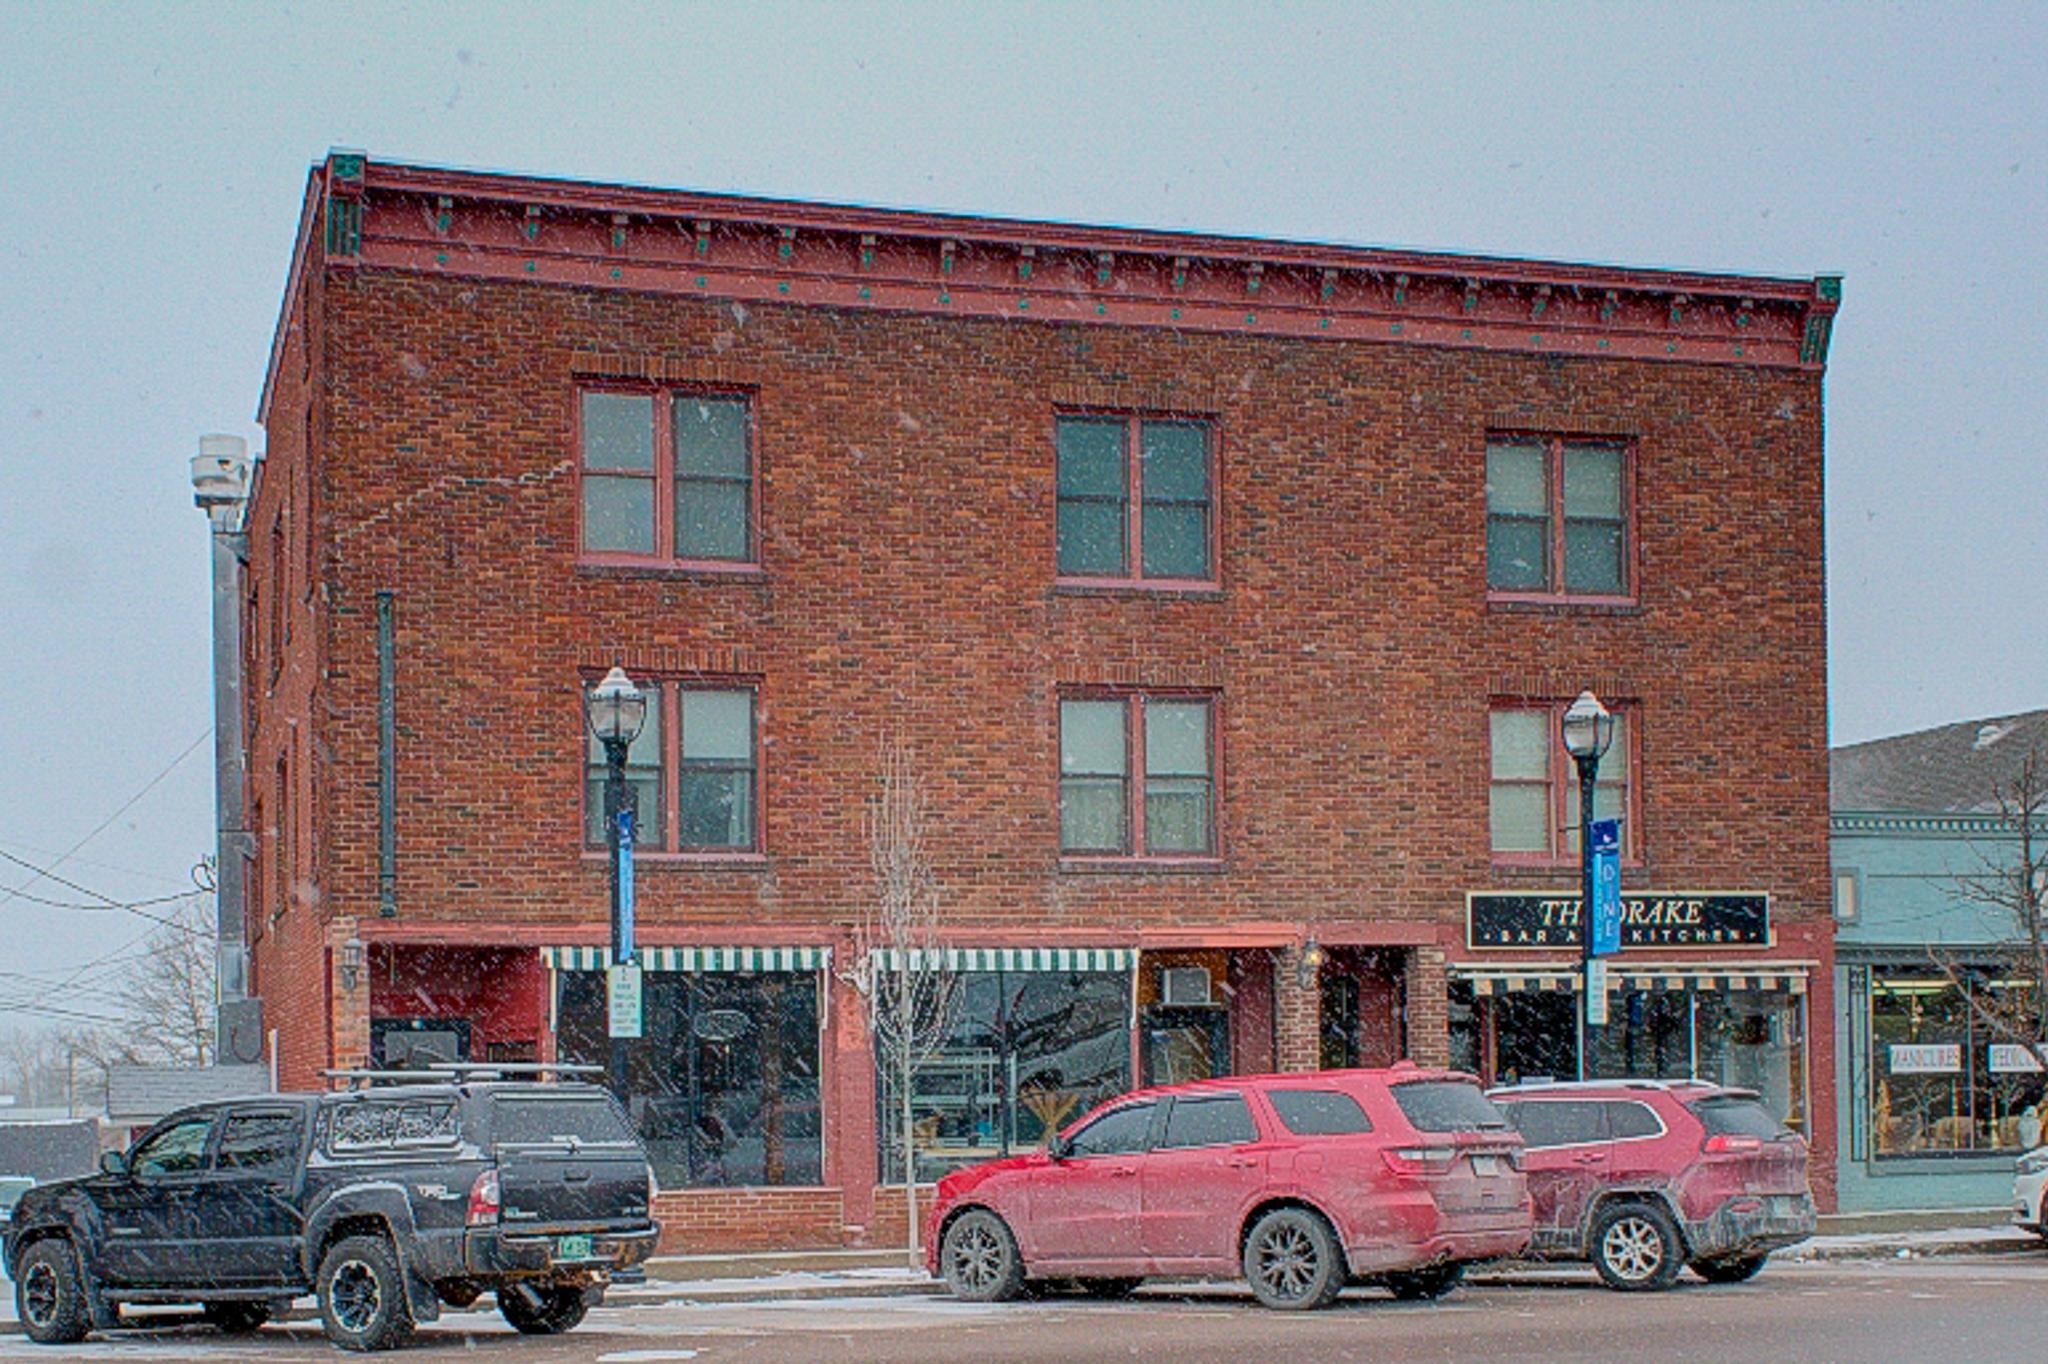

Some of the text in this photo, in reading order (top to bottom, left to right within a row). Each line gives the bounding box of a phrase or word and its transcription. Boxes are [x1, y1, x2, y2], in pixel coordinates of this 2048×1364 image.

[1540, 900, 1583, 925] TH
[1603, 863, 1616, 937] DINE
[1501, 929, 1741, 942] BAR KITCHEN
